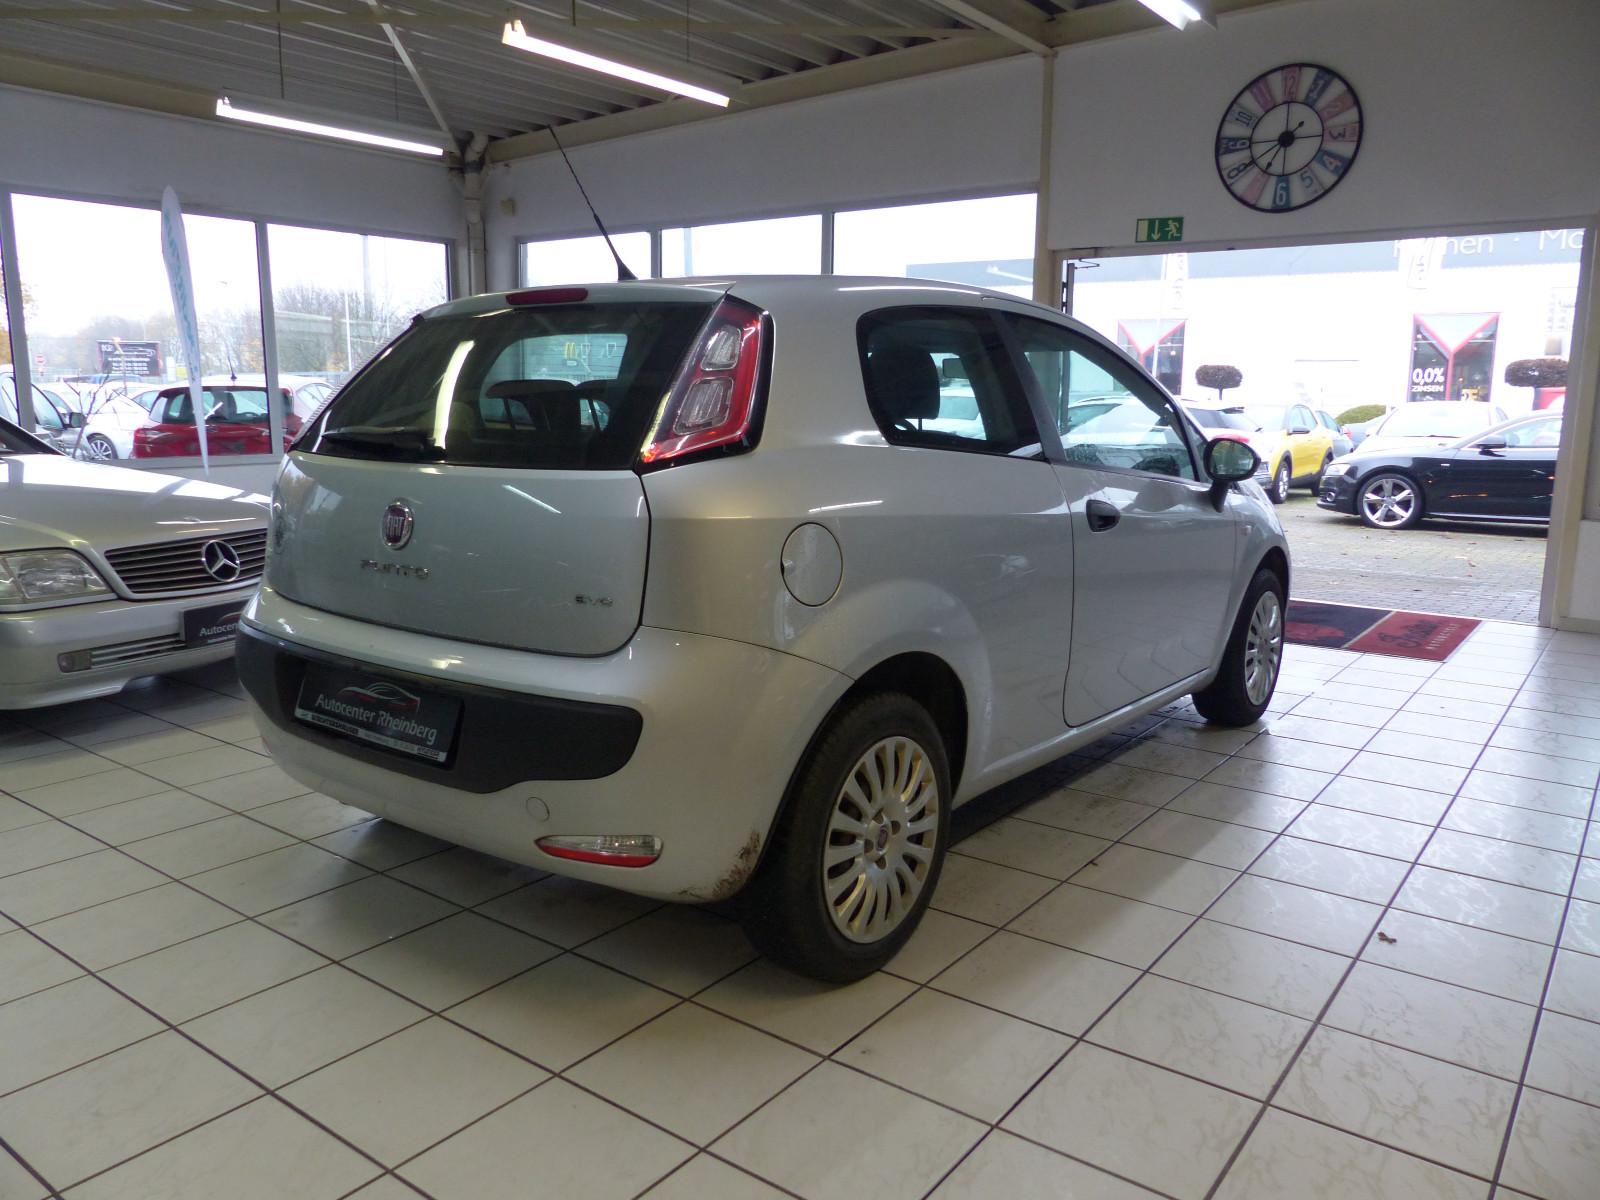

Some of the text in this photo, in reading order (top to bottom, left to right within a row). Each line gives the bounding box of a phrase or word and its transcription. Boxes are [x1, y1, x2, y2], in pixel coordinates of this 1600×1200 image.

[1235, 111, 1252, 128] 10
[1329, 127, 1346, 141] 3
[1228, 139, 1249, 150] 9
[1227, 162, 1248, 179] 8
[1323, 155, 1341, 170] 4
[1300, 171, 1314, 189] 5
[1275, 182, 1287, 206] 6
[1412, 367, 1445, 386] 0,0%
[1411, 385, 1445, 393] ZINSEN
[200, 622, 239, 637] Autocen
[314, 693, 376, 722] Autocenter
[376, 710, 438, 746] Rheinberg
